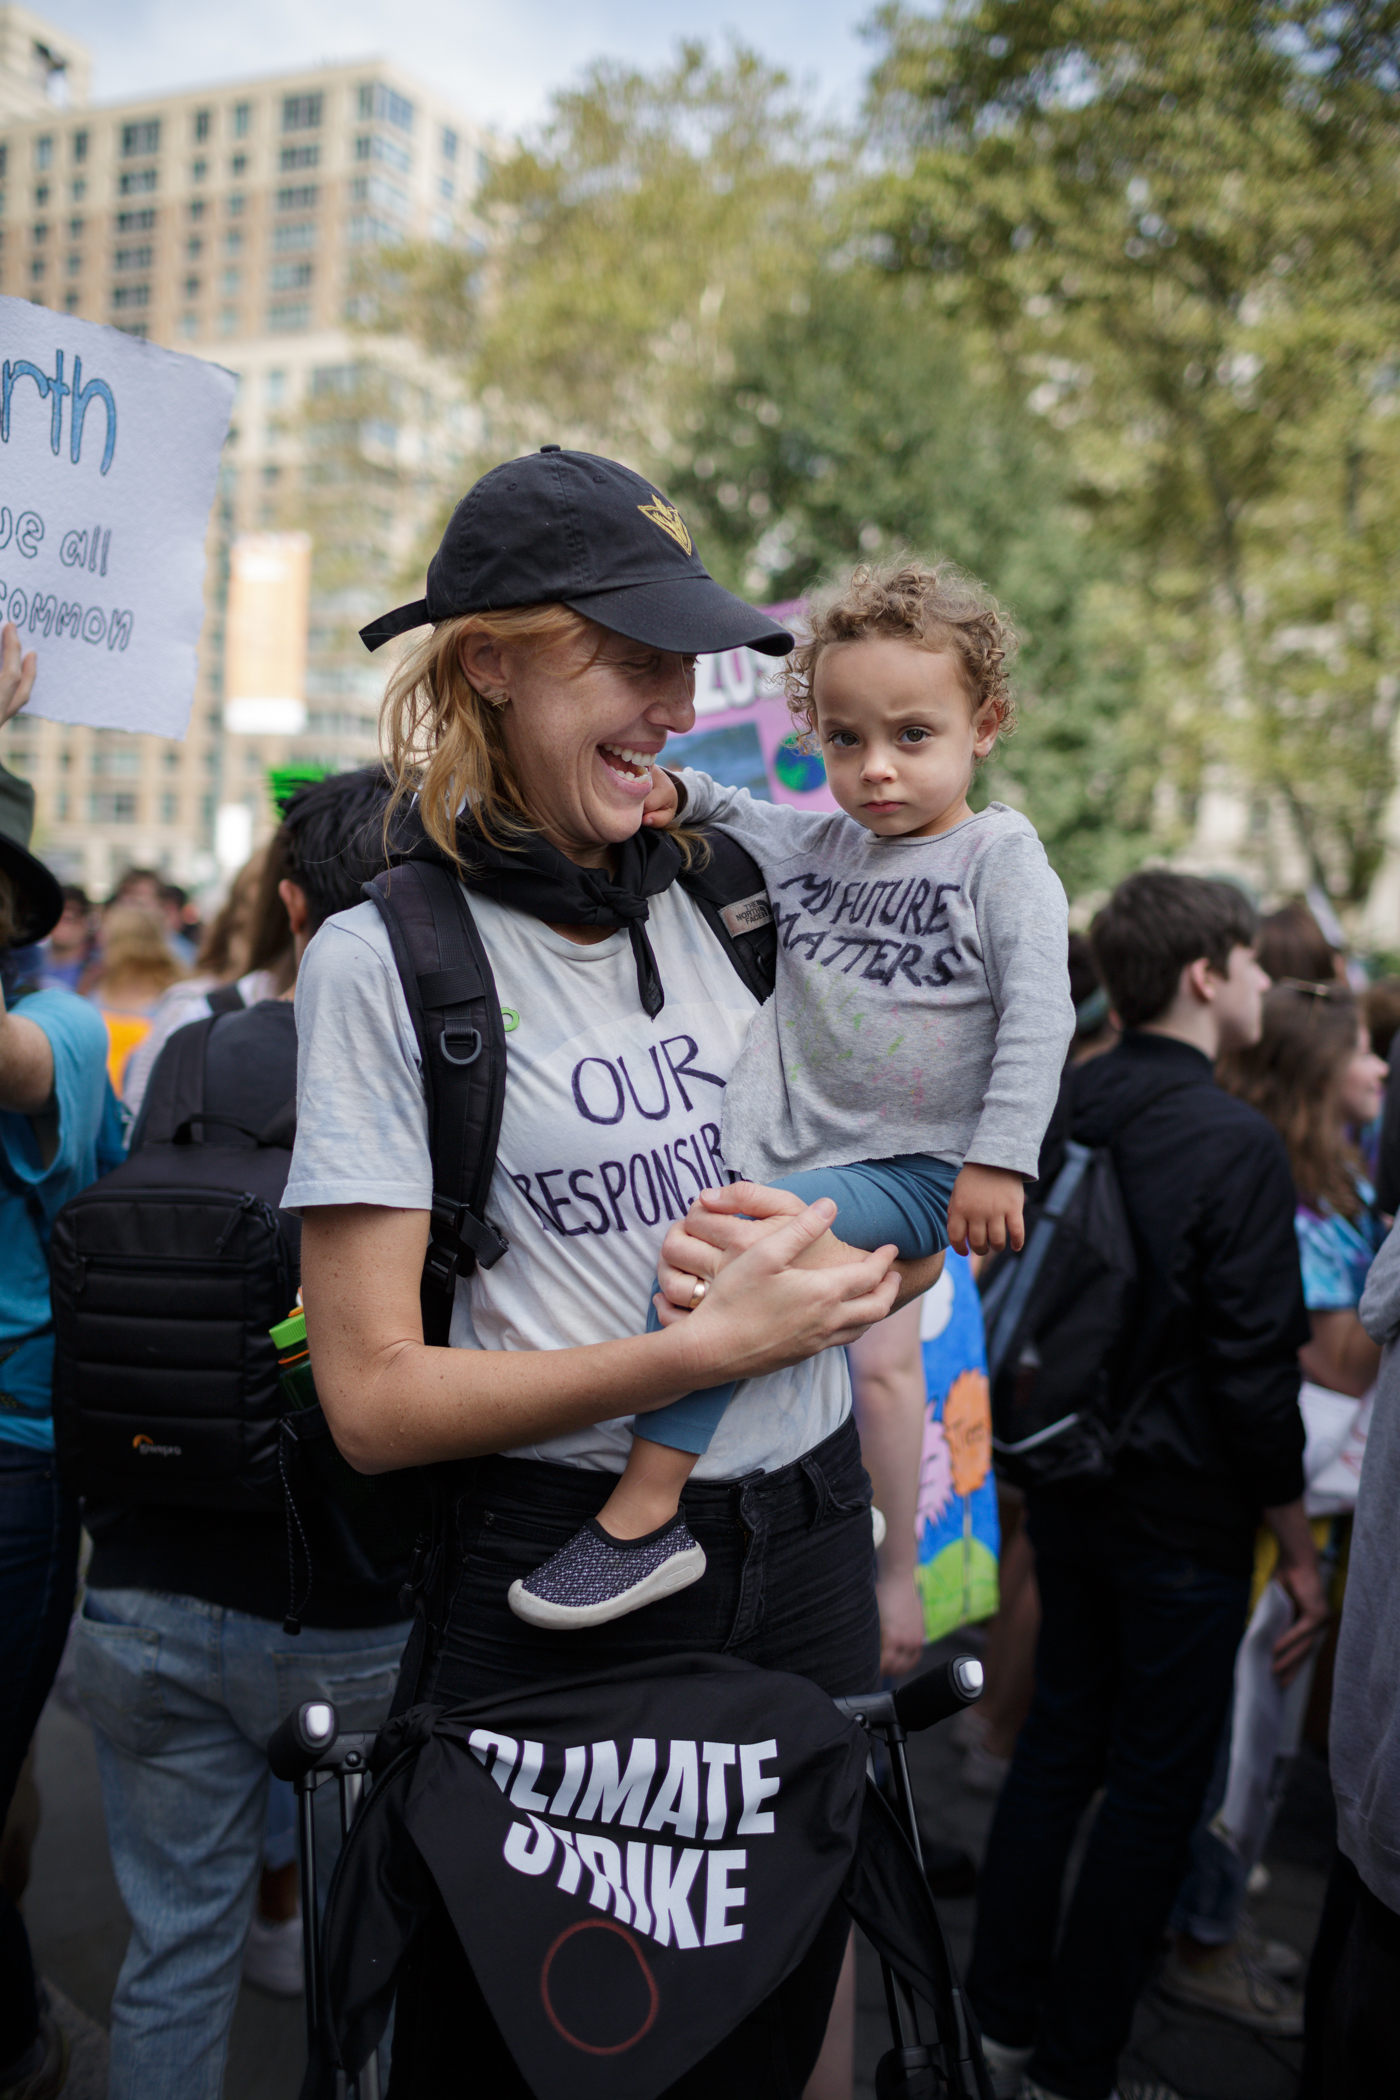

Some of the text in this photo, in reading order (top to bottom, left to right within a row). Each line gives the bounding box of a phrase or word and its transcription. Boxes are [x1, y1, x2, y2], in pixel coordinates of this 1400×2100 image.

[59, 525, 112, 577] all
[0, 580, 134, 651] ommon
[735, 907, 761, 921] NORTH
[743, 901, 759, 911] THE
[745, 912, 765, 925] FACE
[830, 877, 961, 937] FUTURE
[772, 902, 962, 988] MATTERS
[571, 1034, 728, 1126] OUR
